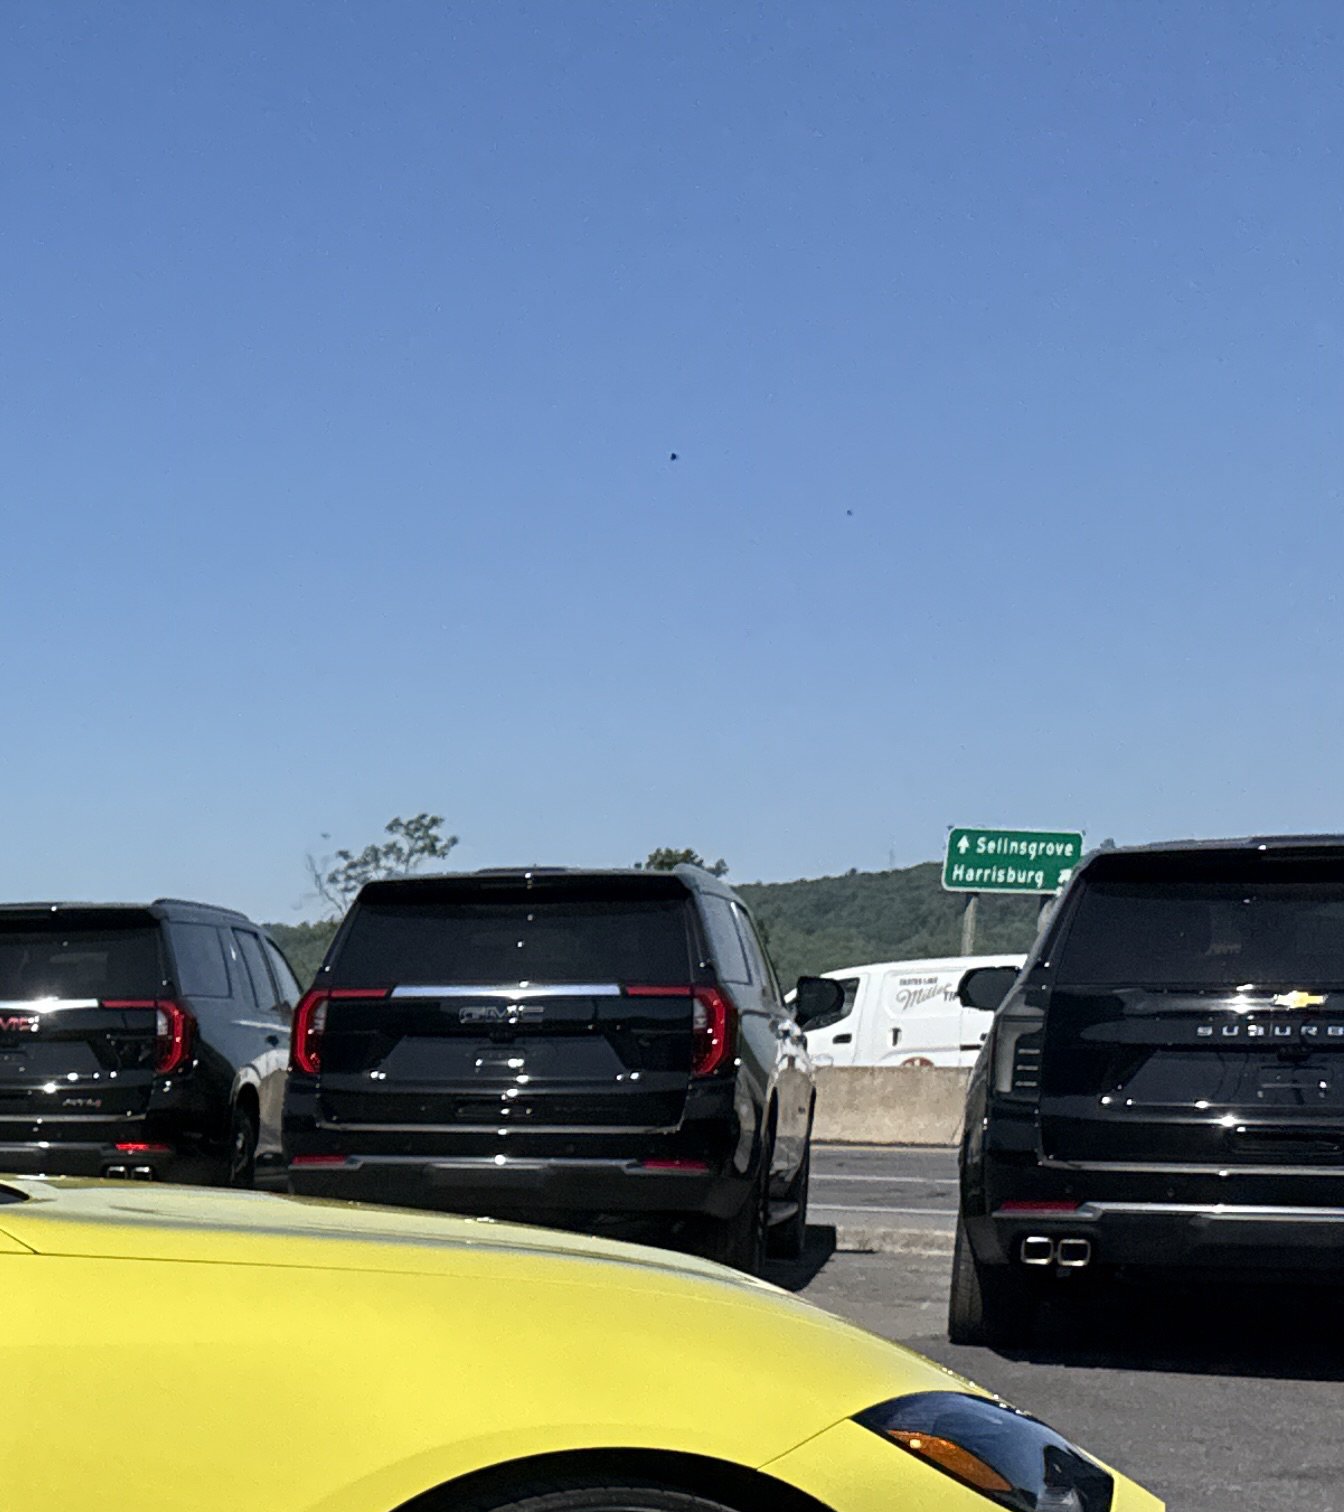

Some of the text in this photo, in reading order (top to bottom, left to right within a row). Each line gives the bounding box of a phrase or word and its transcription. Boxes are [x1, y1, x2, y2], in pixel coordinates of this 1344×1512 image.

[976, 836, 1074, 860] Selinsgrove
[952, 864, 1044, 889] Harrisburg
[459, 1005, 544, 1024] GMC
[1197, 1025, 1344, 1037] SUBURB
